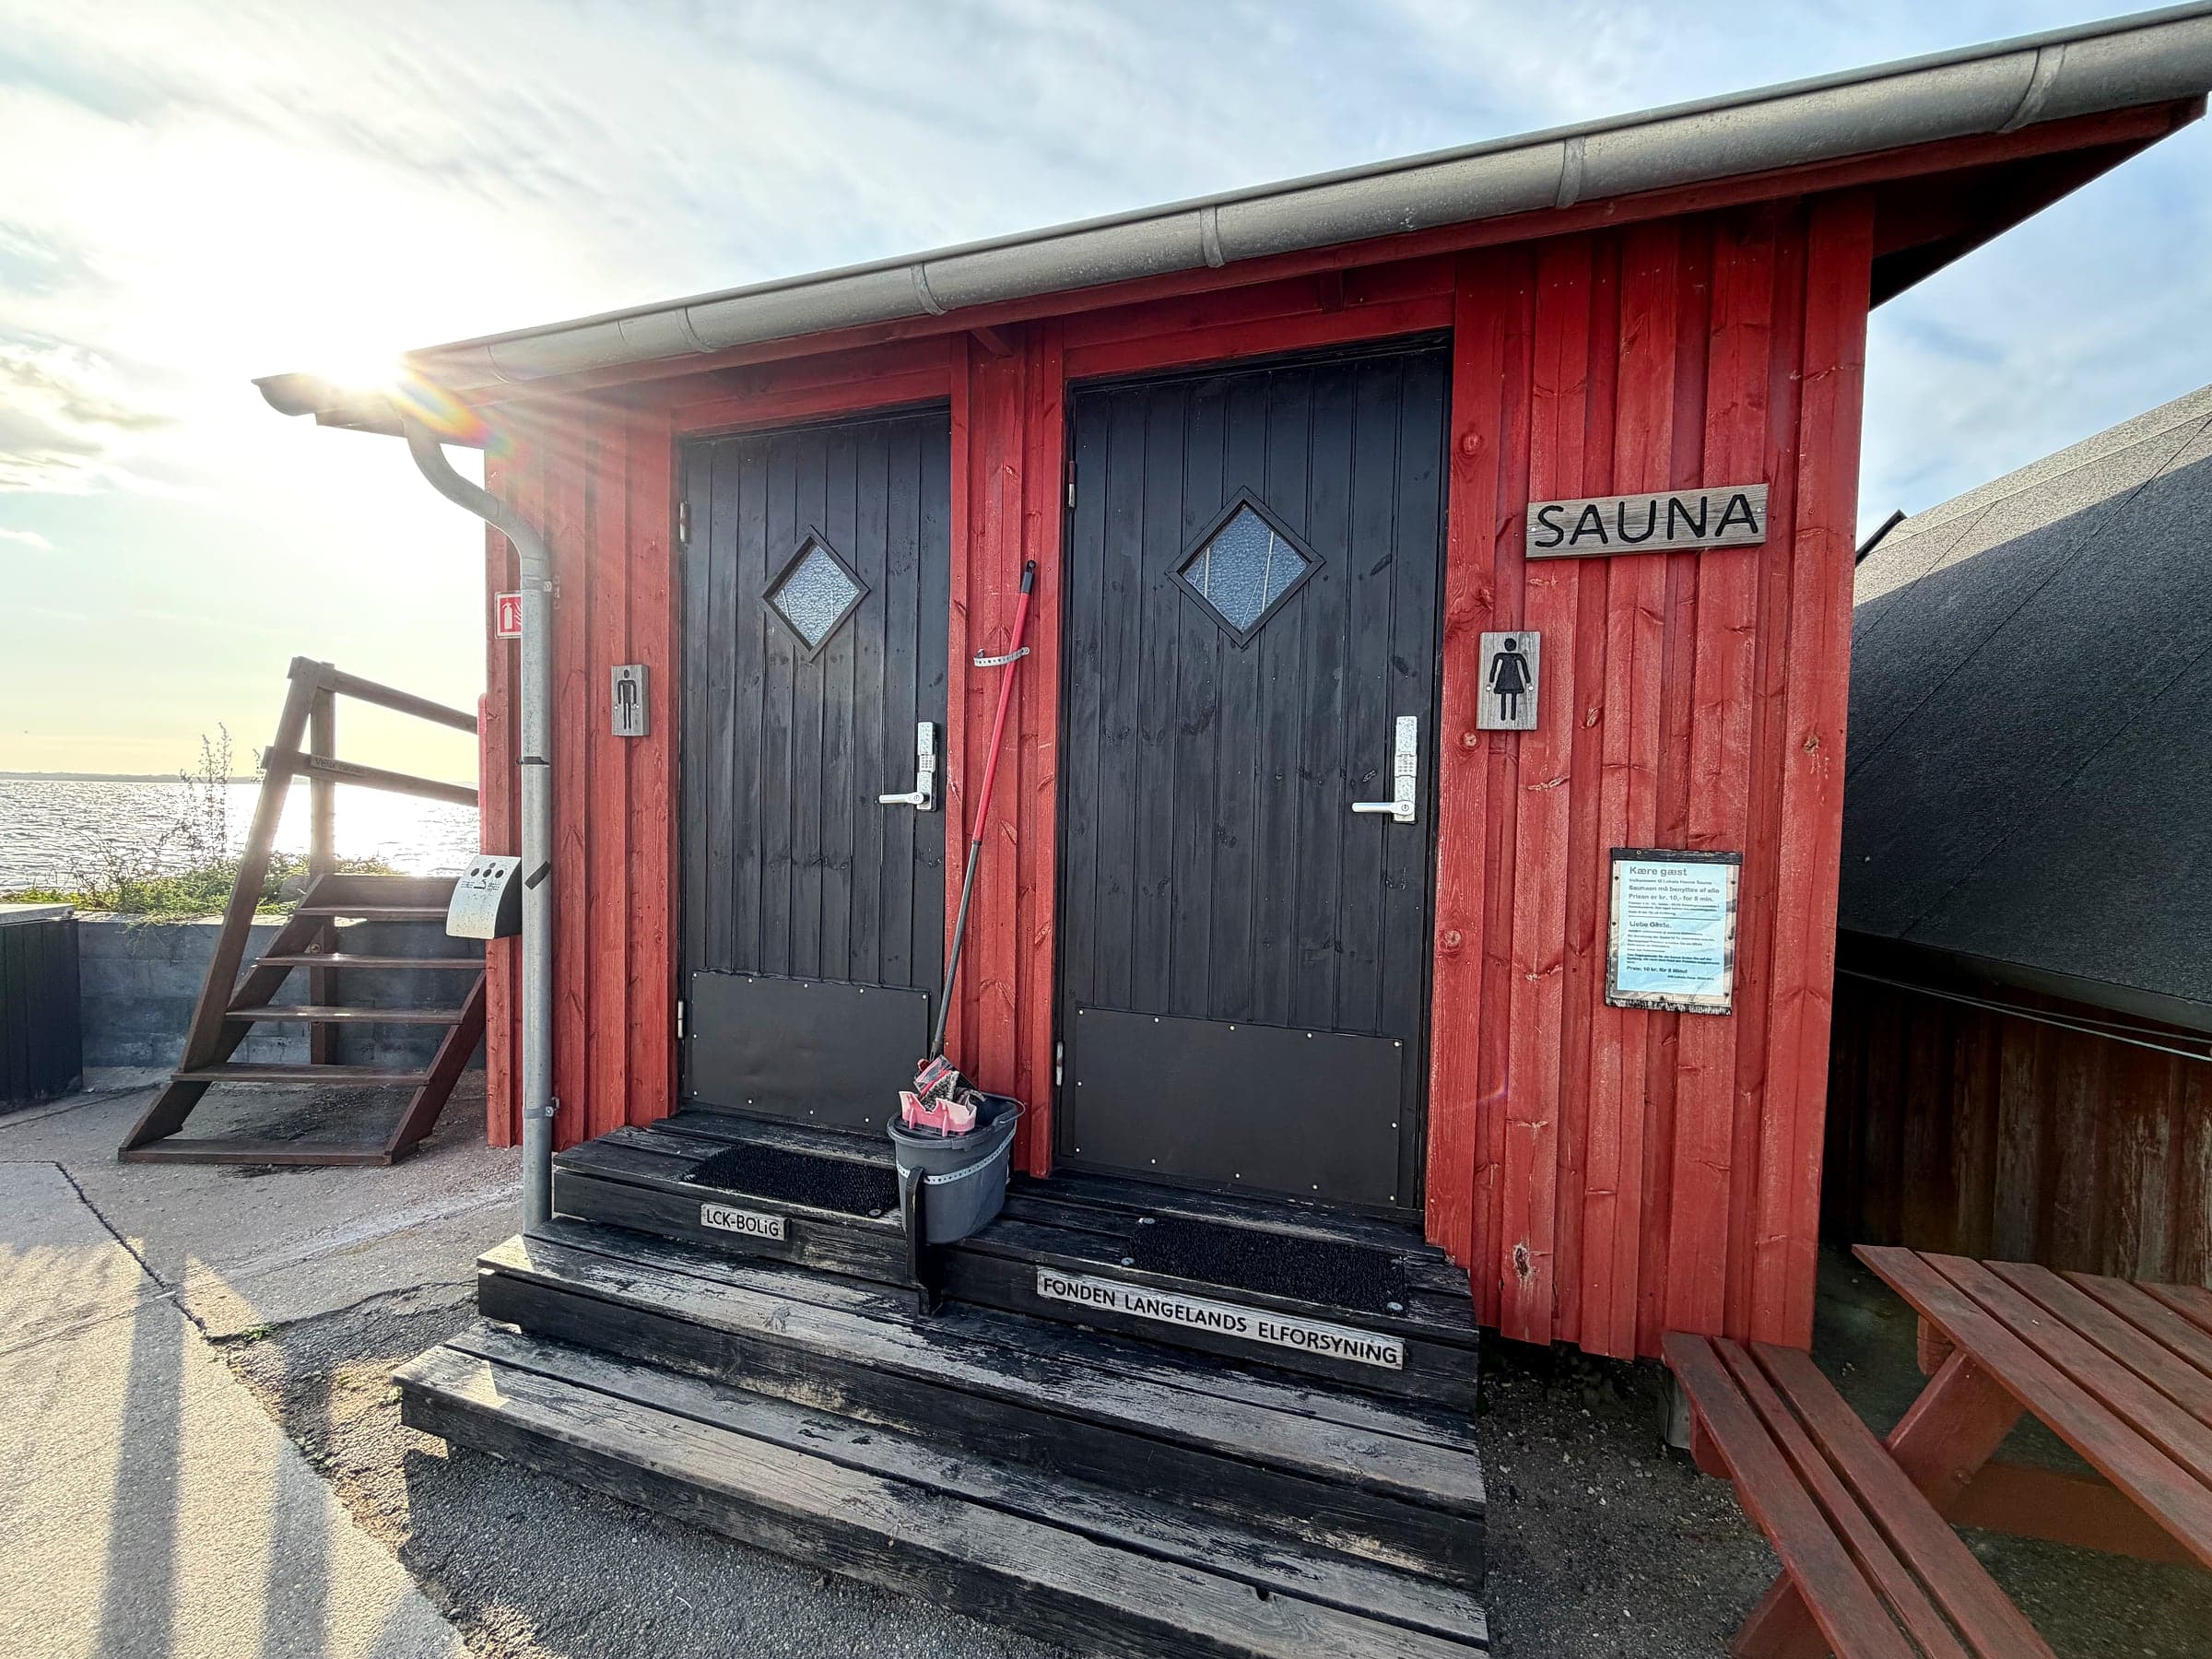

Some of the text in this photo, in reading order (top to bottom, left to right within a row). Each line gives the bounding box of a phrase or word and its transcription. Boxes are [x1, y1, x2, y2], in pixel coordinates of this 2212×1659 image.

[1535, 493, 1759, 547] SAUNA
[1630, 866, 1688, 877] Kære gæst
[707, 1209, 779, 1237] LCK-BOLiG
[1043, 1277, 1398, 1364] FONDEN LANGELANDS ELFORSYNING
